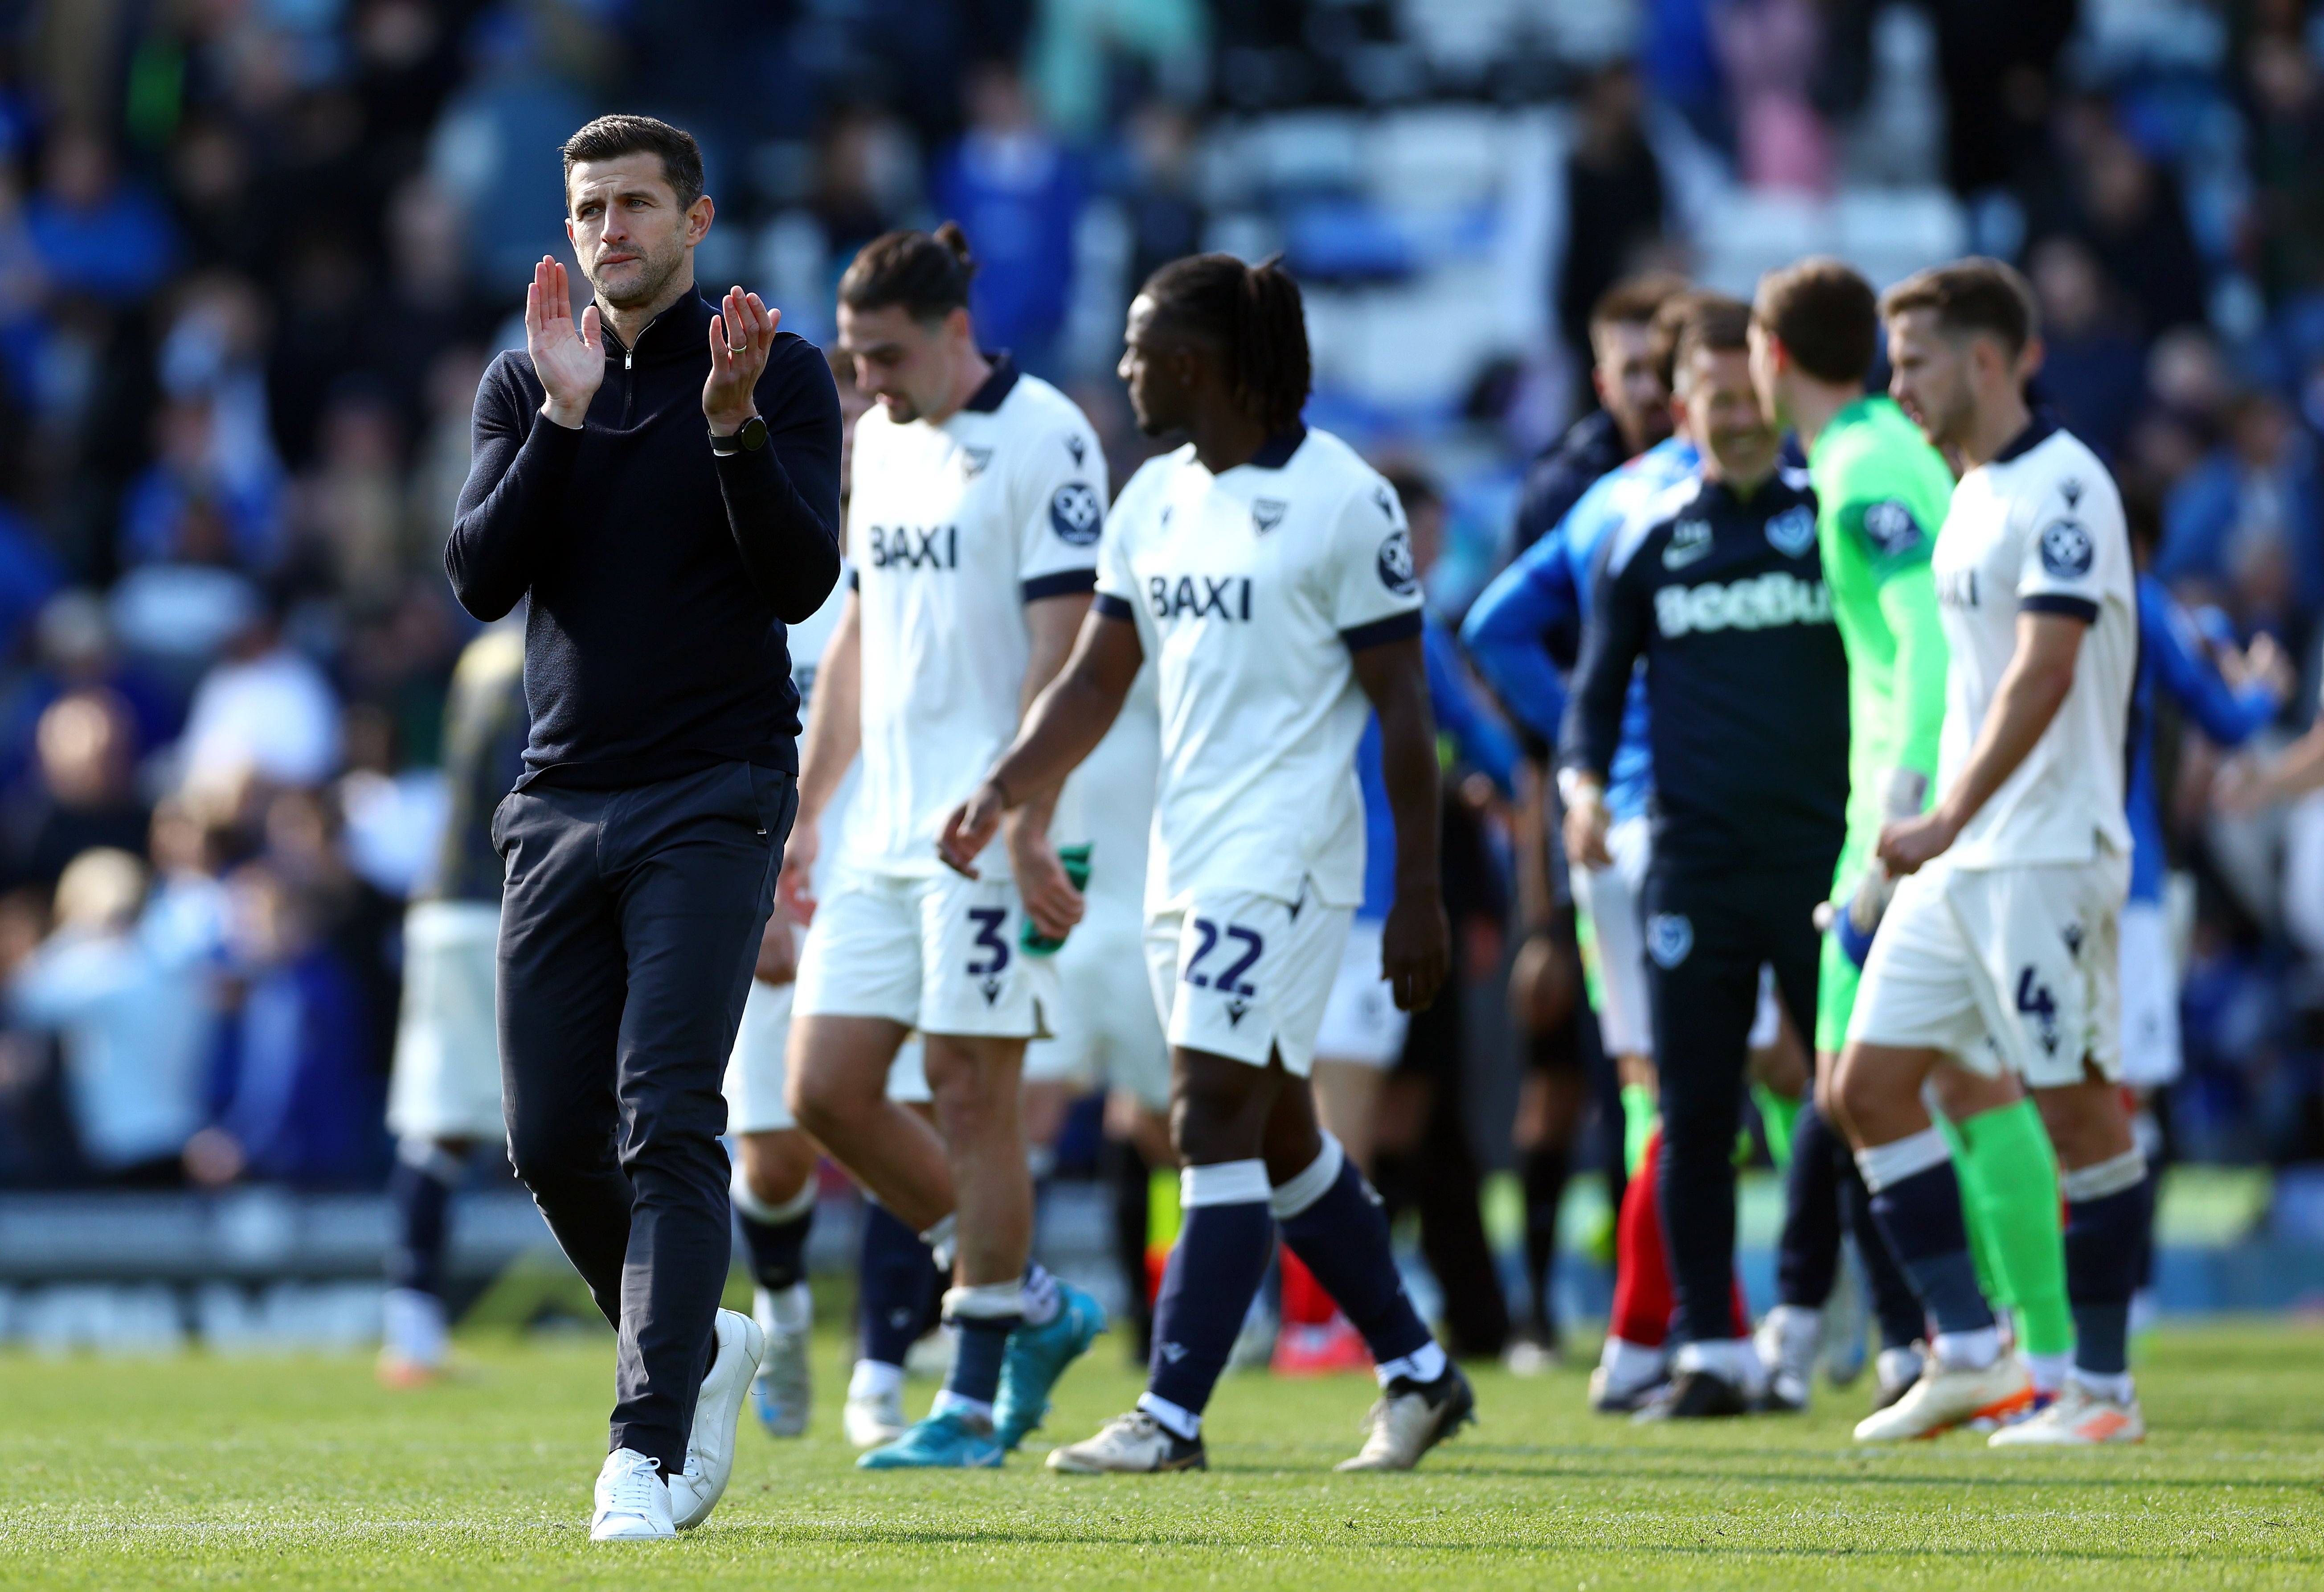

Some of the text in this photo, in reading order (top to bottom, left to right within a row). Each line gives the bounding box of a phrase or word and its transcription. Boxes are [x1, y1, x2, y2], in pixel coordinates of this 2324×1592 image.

[870, 525, 957, 568] BAXI
[1150, 576, 1251, 620] BAXI
[968, 907, 1010, 973] 3
[1184, 919, 1263, 997] 22
[2016, 964, 2056, 1025] 4
[625, 1451, 644, 1459] ANDROID
